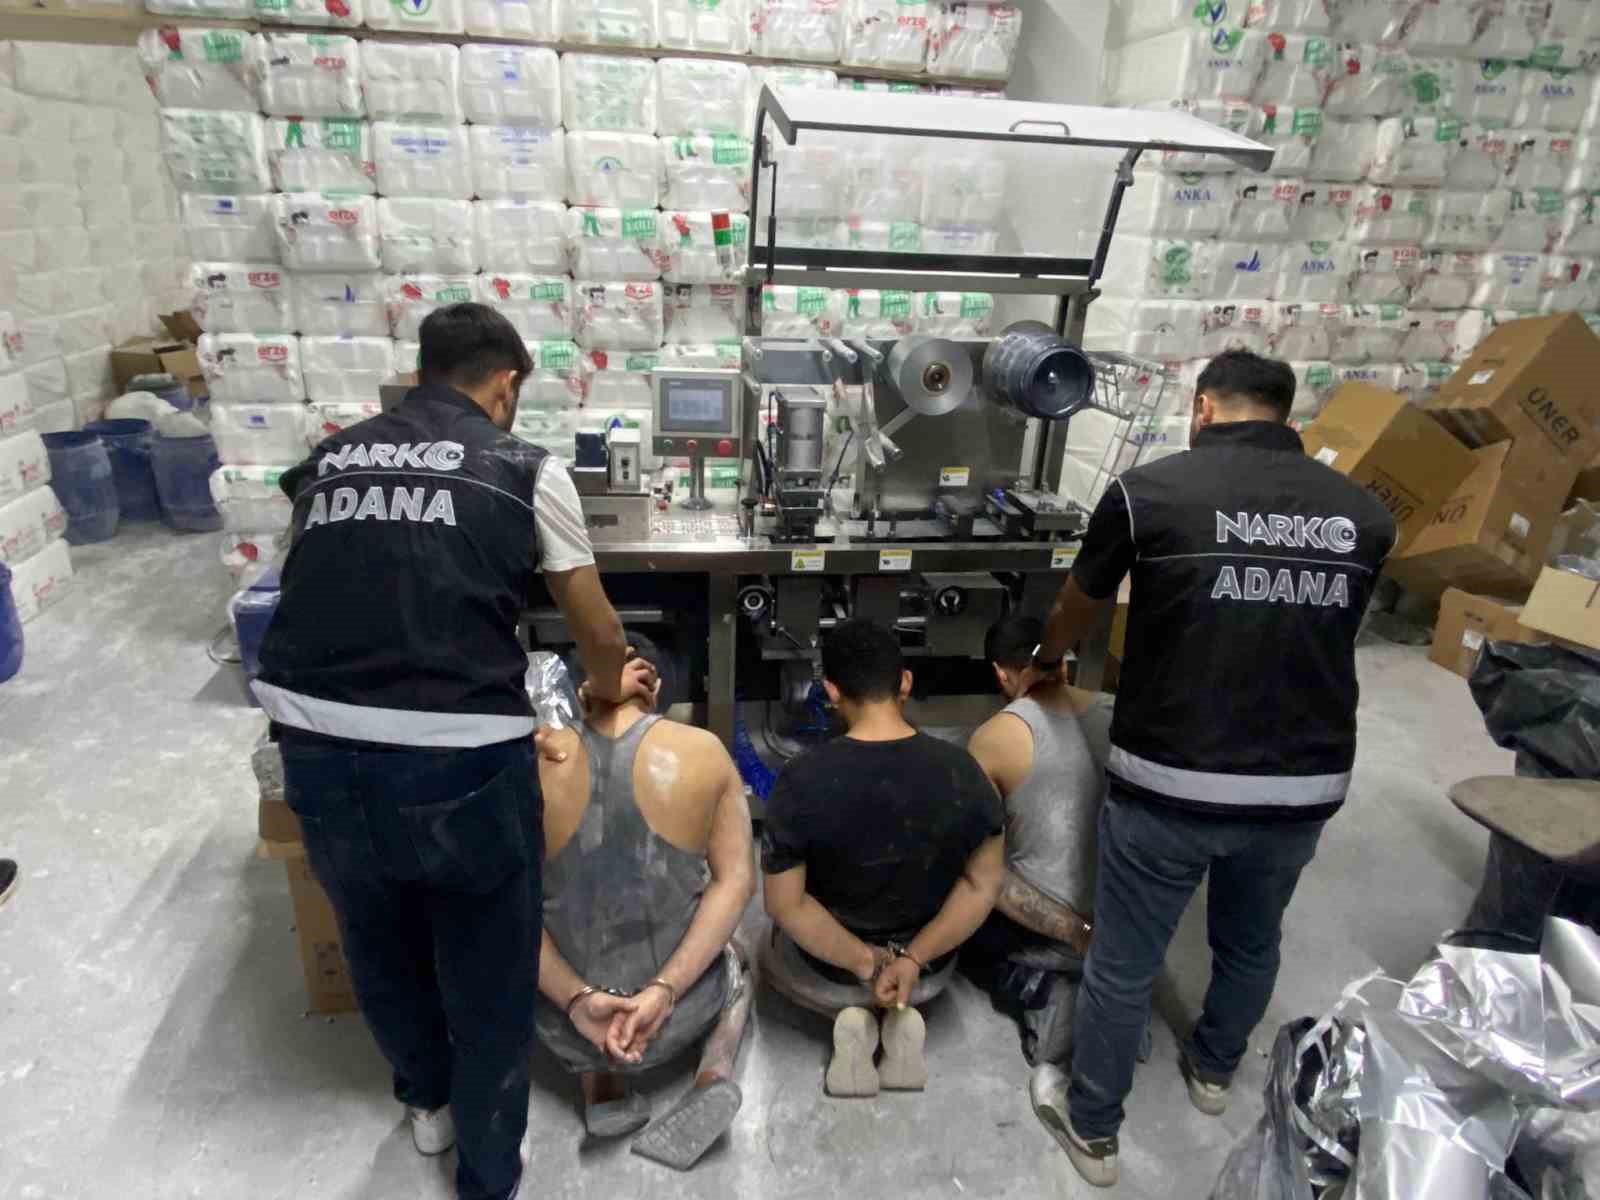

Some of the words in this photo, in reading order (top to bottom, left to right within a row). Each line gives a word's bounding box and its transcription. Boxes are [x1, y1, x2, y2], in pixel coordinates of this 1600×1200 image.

[1174, 188, 1211, 201] ANKA
[1300, 259, 1335, 272] ANKA
[304, 486, 457, 530] ADANA
[1210, 566, 1349, 608] ADANA
